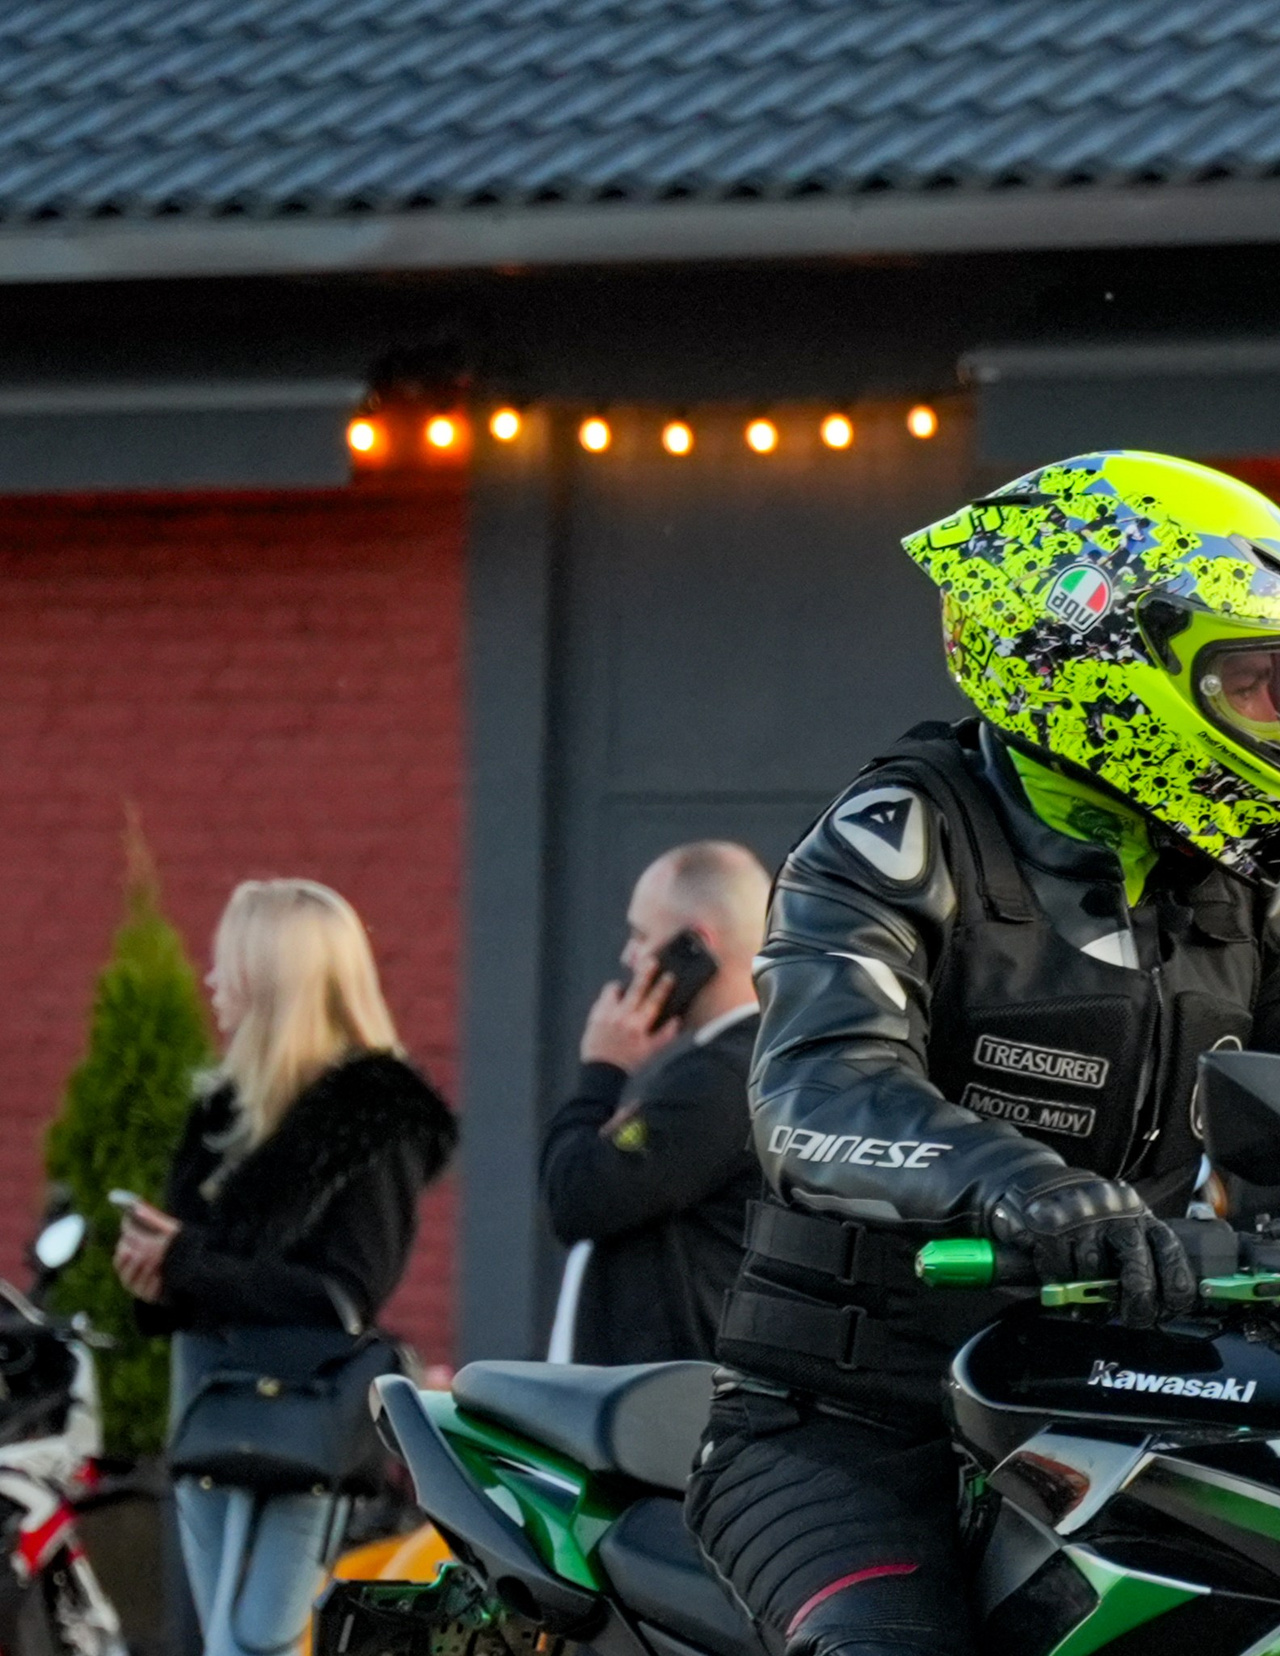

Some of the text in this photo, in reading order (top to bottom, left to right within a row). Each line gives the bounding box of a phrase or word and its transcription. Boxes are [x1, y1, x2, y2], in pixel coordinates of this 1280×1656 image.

[1052, 592, 1093, 625] agv
[984, 1042, 1099, 1083] TREASURER
[768, 1125, 953, 1168] DAINESE
[1088, 1360, 1257, 1403] Kawasaki
